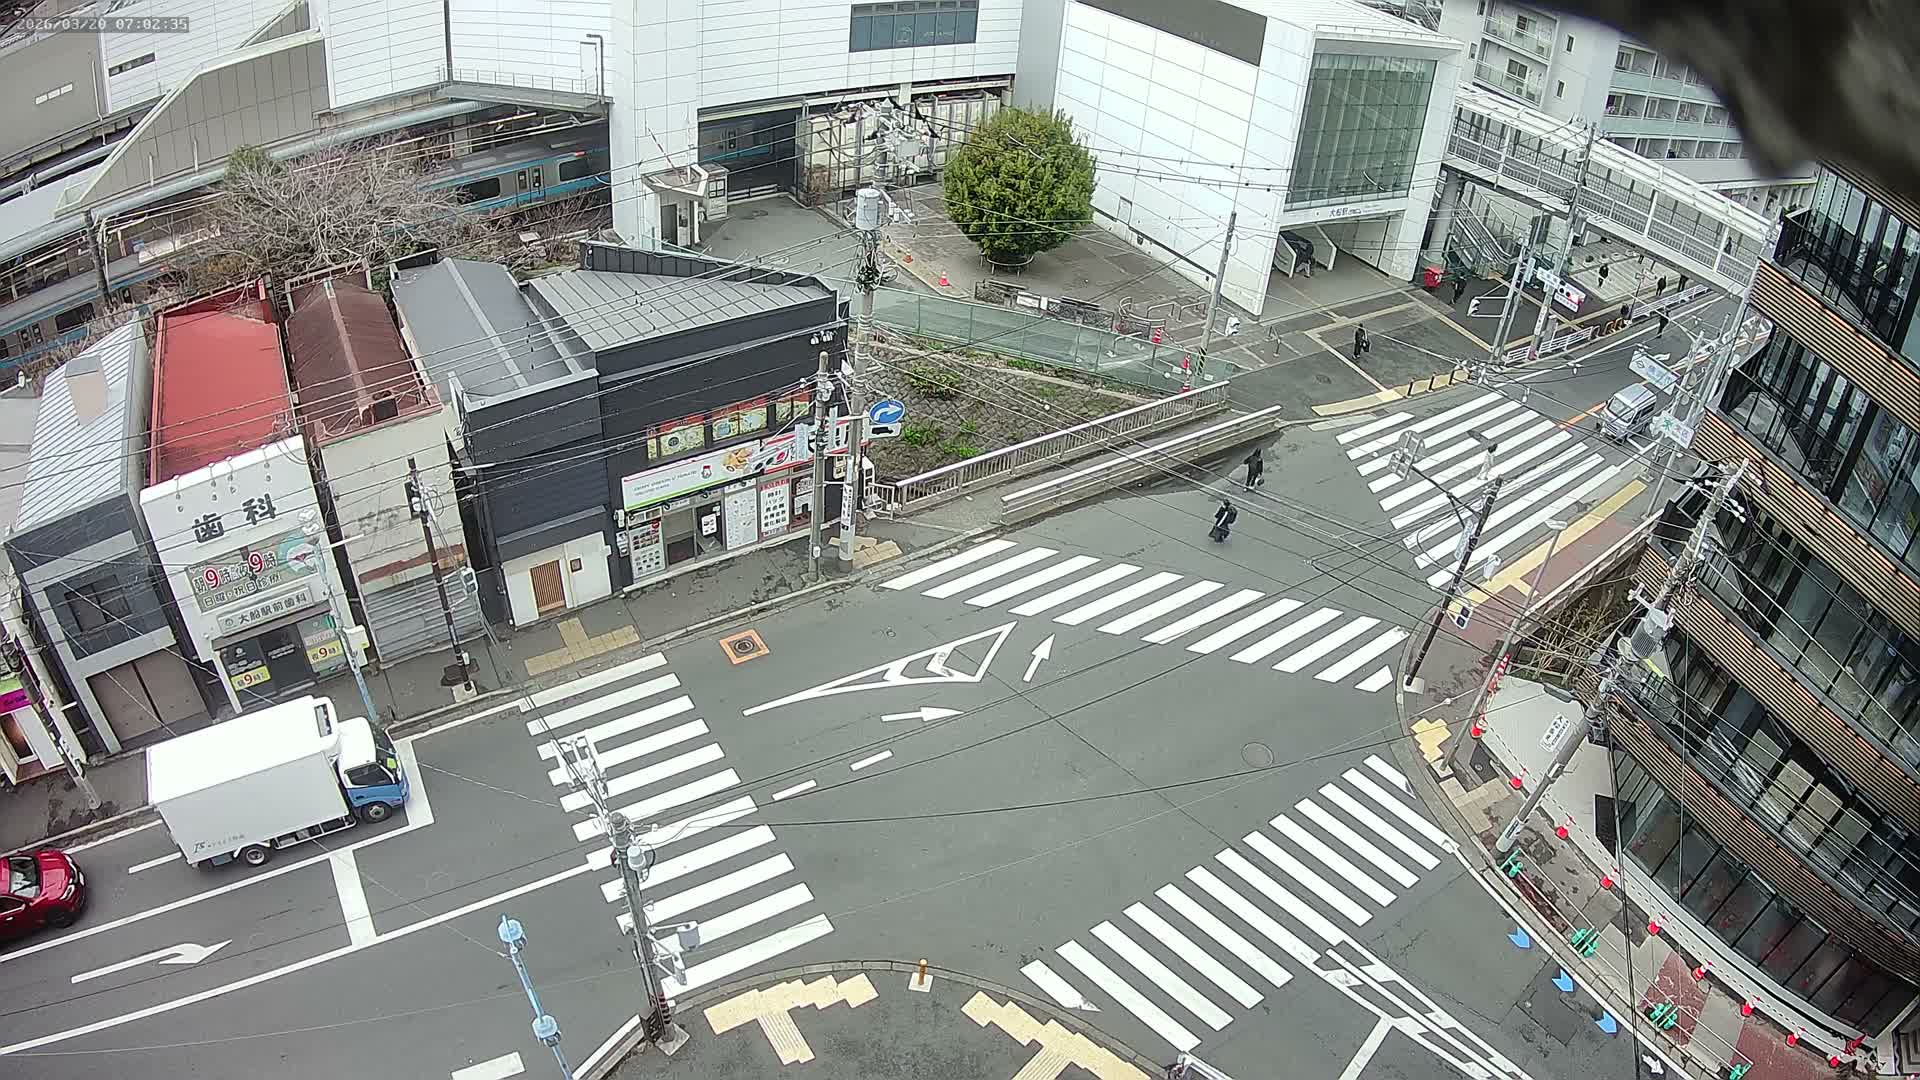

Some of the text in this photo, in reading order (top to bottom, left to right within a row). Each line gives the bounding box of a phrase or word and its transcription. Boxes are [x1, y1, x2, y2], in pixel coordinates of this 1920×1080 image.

[192, 493, 277, 543] 歯科
[239, 592, 307, 625] 大船駅前歯科
